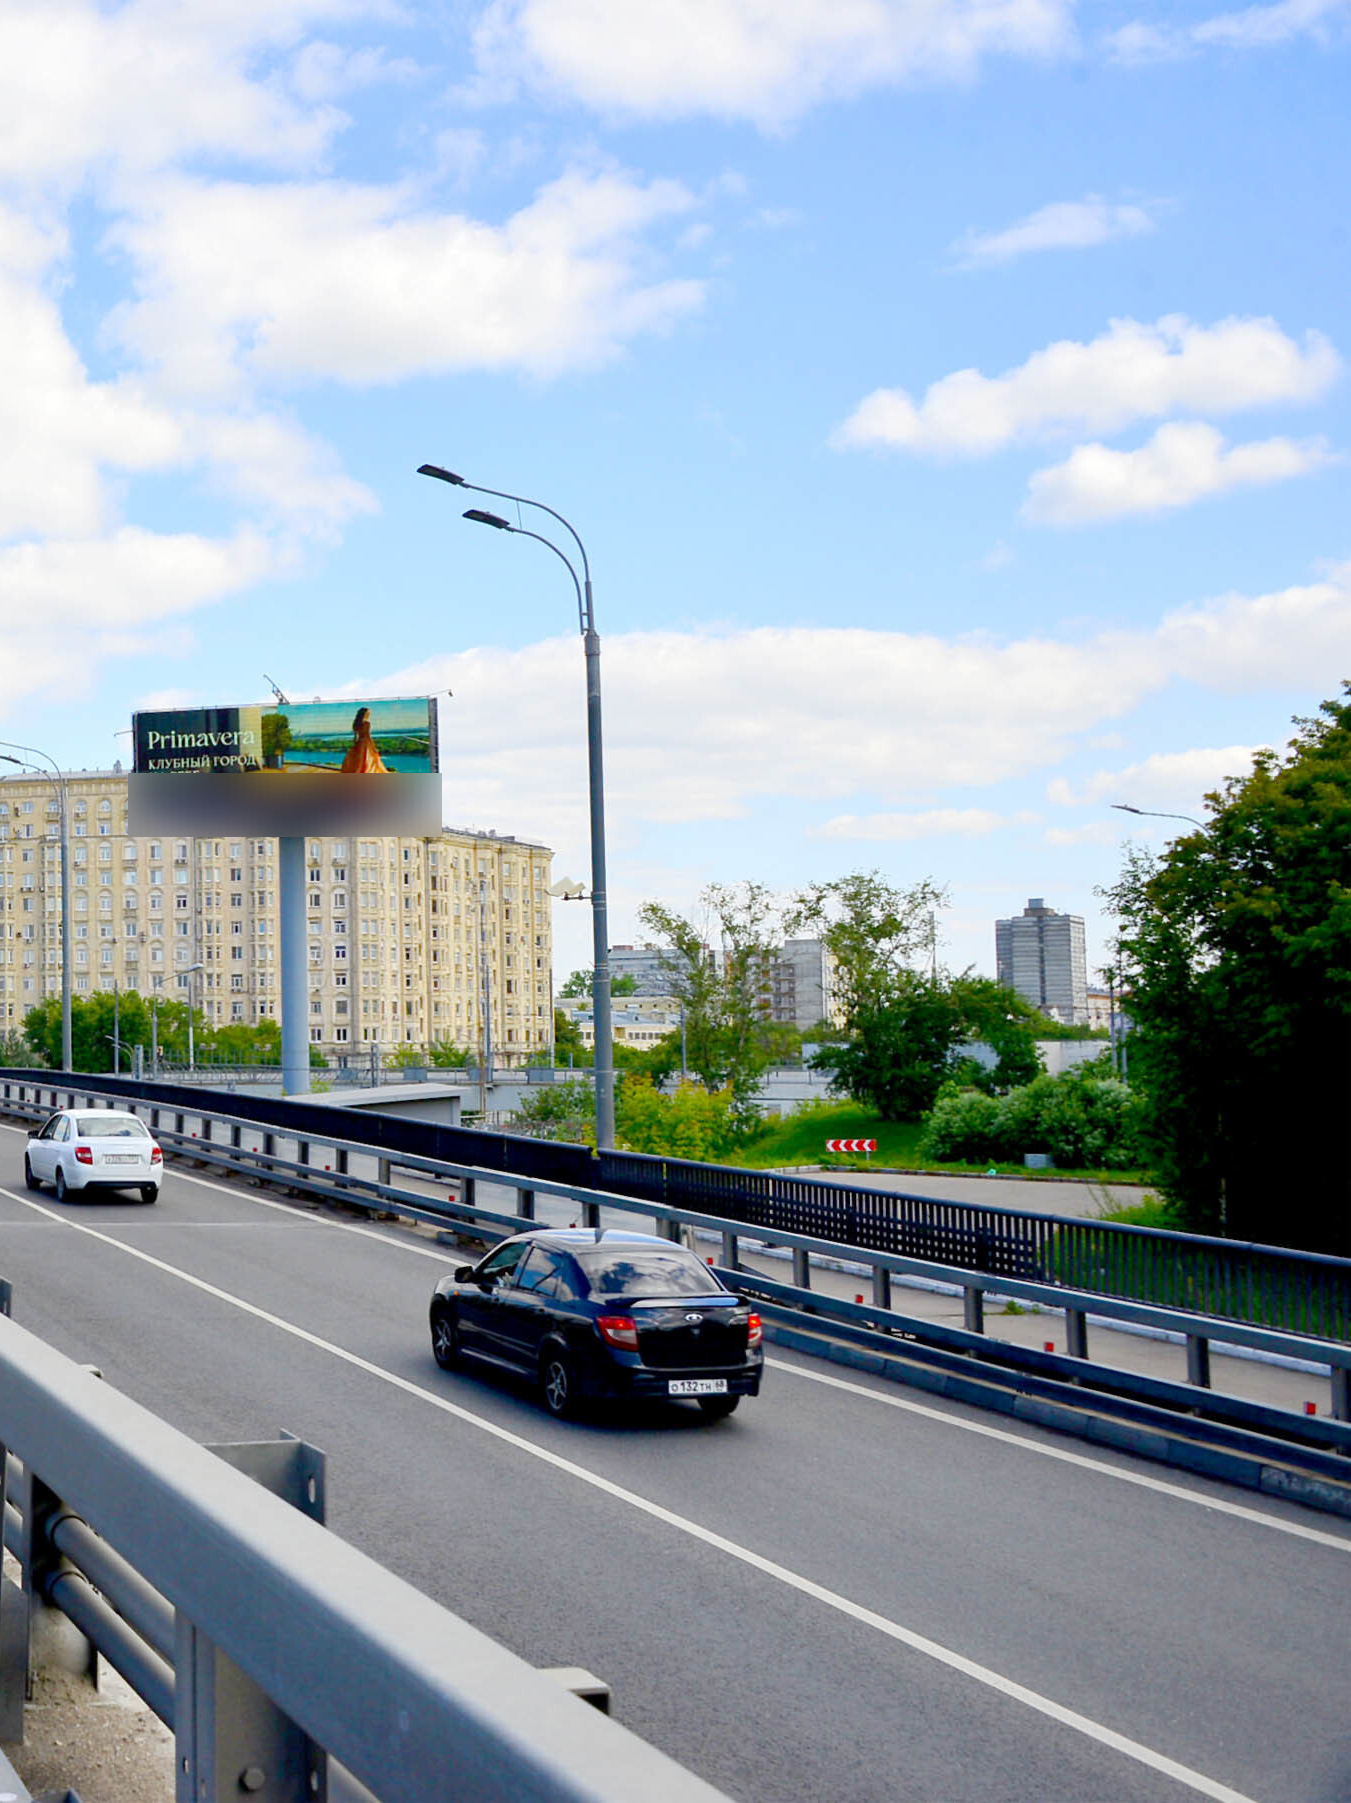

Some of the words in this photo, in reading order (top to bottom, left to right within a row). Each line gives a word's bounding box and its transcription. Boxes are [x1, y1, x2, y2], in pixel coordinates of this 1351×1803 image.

[148, 730, 255, 750] Primavera
[149, 754, 210, 770] КЛУБНЫЙ
[213, 754, 256, 767] ГОРОД
